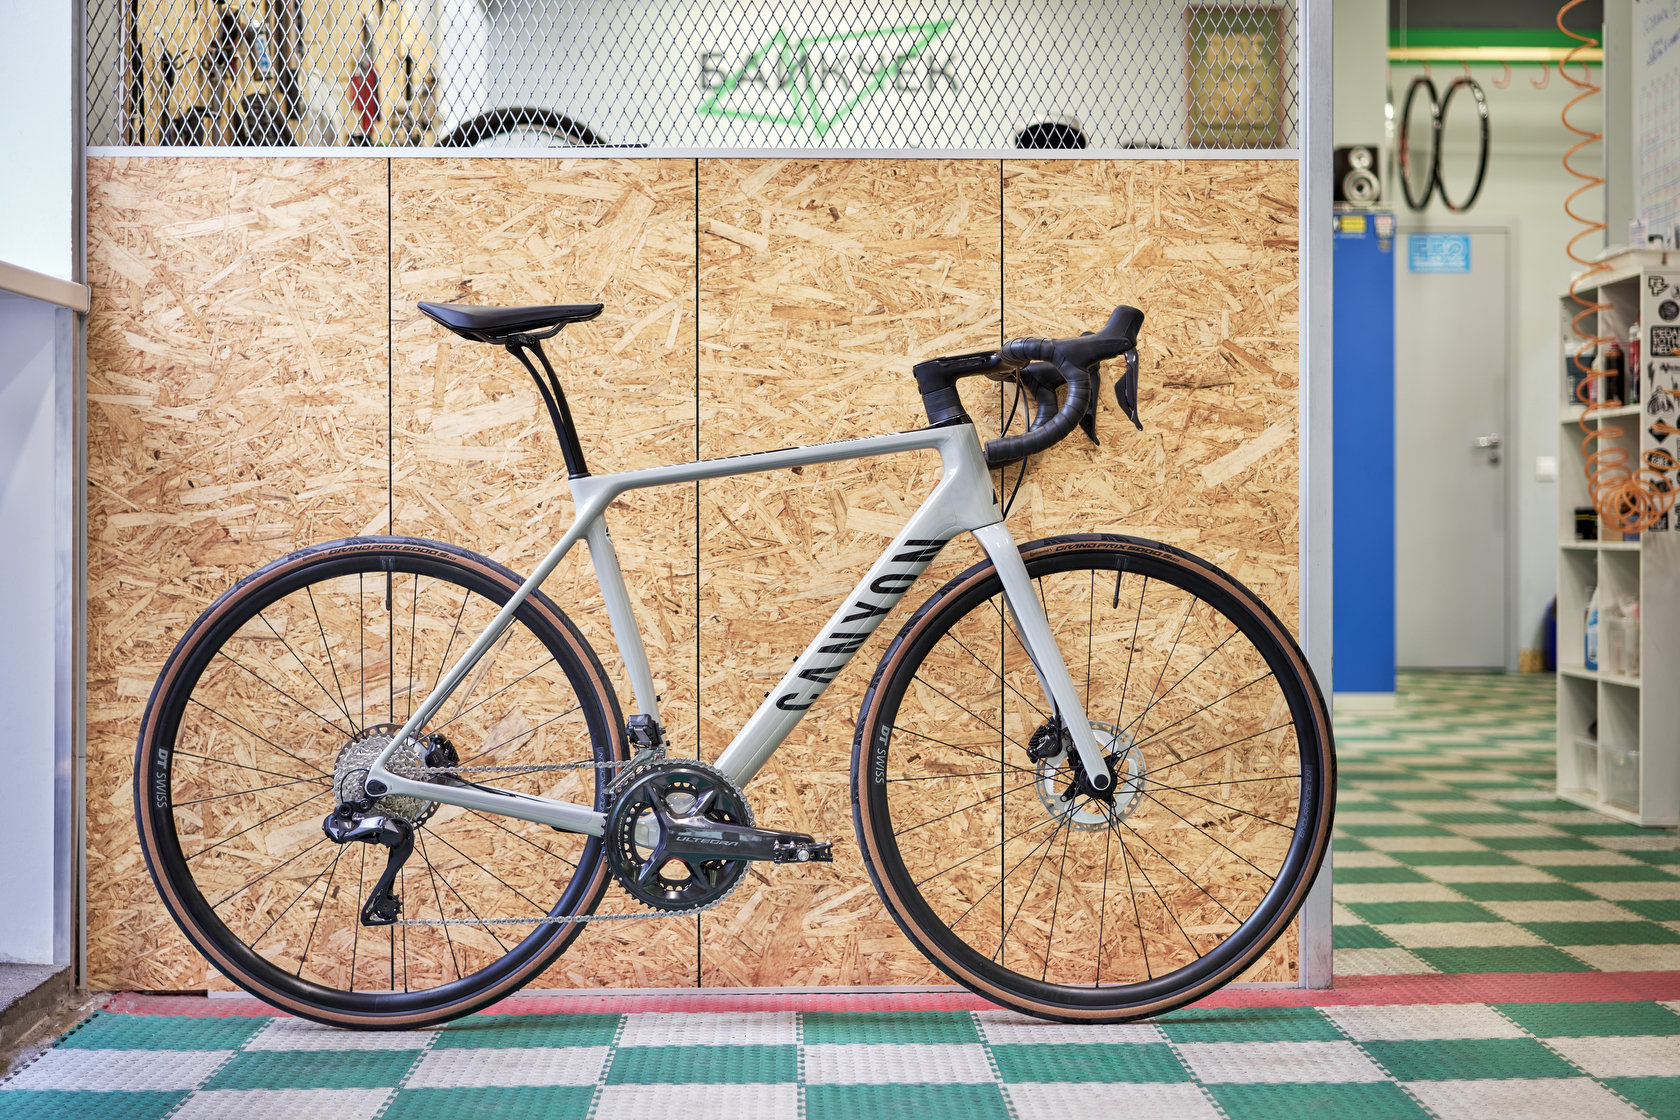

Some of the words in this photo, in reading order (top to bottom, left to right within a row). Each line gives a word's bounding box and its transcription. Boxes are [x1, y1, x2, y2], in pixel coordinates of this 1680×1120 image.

[328, 544, 370, 555] GRAND
[402, 545, 439, 556] 5000
[1055, 543, 1096, 551] GRAND
[1126, 545, 1161, 556] 5000
[776, 539, 951, 711] CANYON
[880, 725, 891, 746] DT
[157, 748, 169, 769] DT
[875, 748, 887, 784] SWISS
[156, 772, 168, 808] SWISS
[675, 836, 739, 847] ULTEGRA
